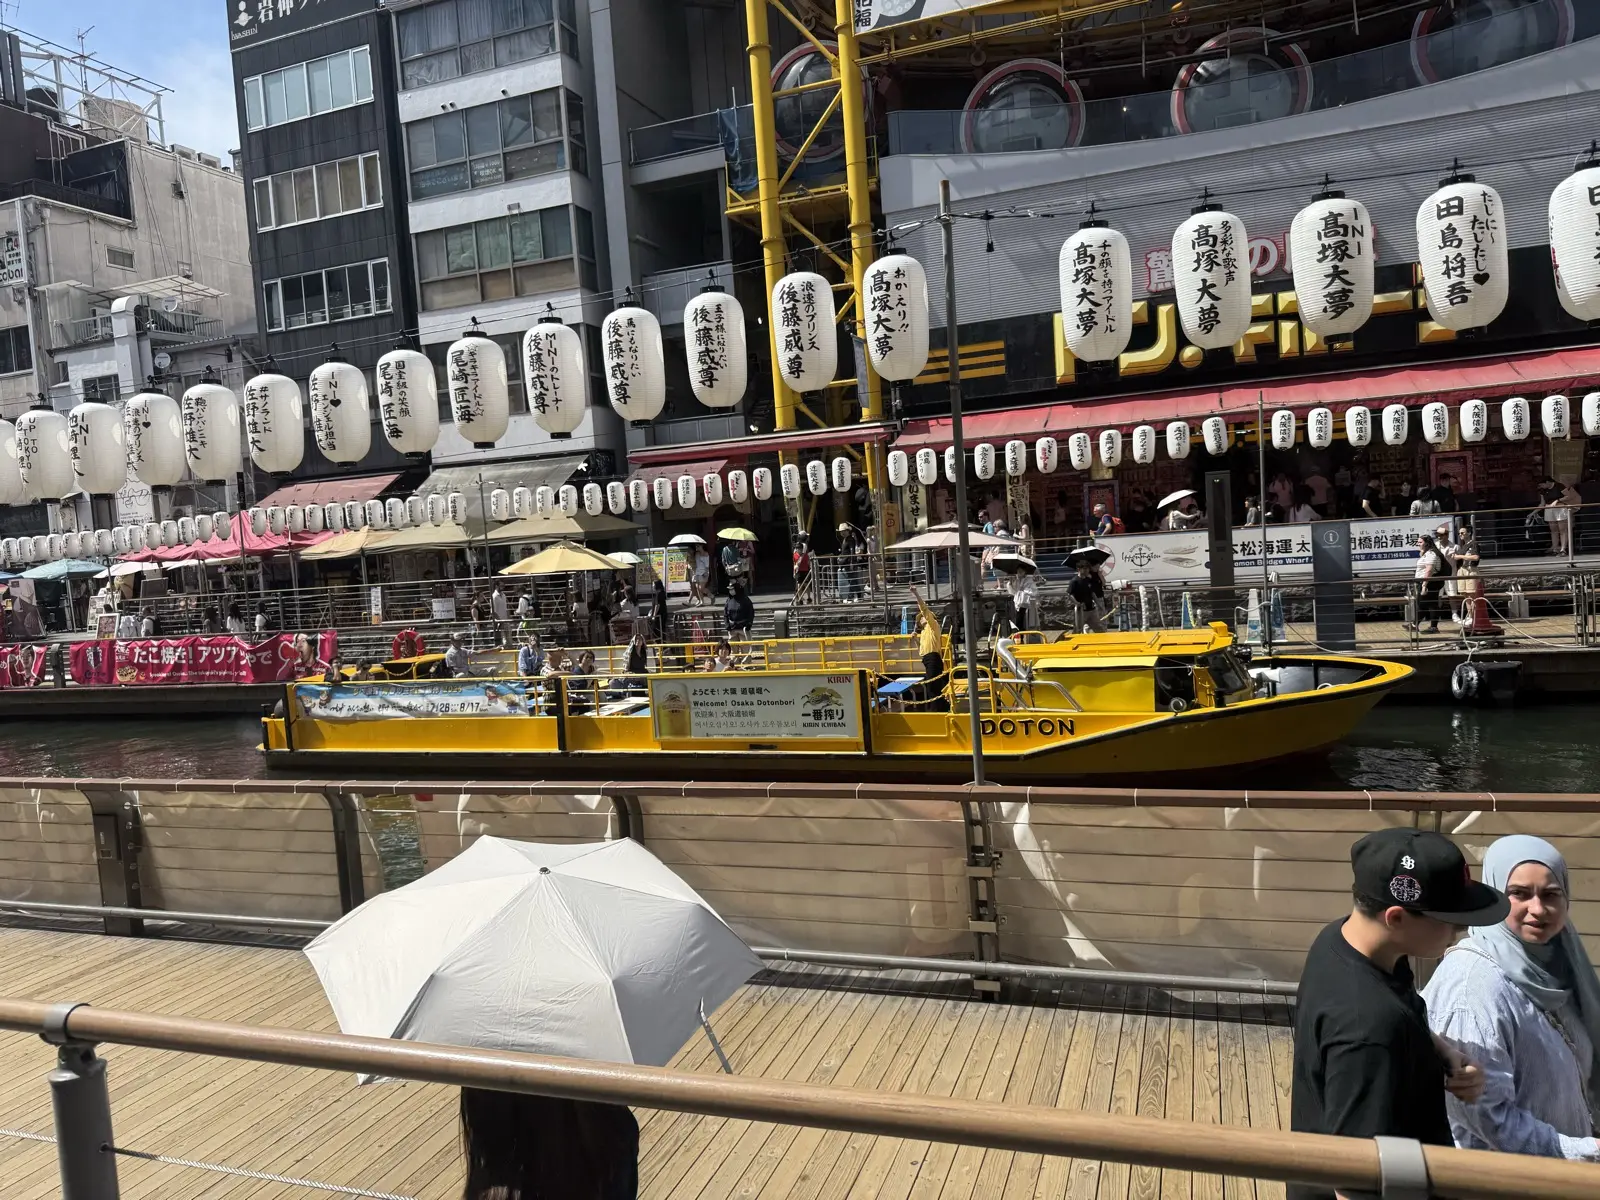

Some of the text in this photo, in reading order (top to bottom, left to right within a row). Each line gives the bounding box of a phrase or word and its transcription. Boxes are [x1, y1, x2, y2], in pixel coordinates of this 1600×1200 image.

[1219, 220, 1239, 287] 多彩な歌声
[1350, 207, 1364, 256] INI
[1436, 195, 1471, 307] 田島将吾
[800, 281, 820, 351] 浪速のプリンス
[1097, 239, 1117, 334] 千の顔を持つアイドル
[606, 318, 631, 405] 後藤威尊
[692, 305, 719, 389] 後藤威尊
[714, 303, 727, 369] 王子様になりたい
[779, 283, 805, 379] 後藤威尊
[329, 371, 338, 400] INI
[379, 361, 403, 440] 尾崎匠海
[395, 360, 411, 418] 国宝級の笑顔
[450, 349, 475, 423] 尾崎匠海
[527, 332, 550, 414] 後藤威尊
[79, 413, 89, 446] INI
[245, 385, 266, 452] 佐野雄大
[321, 394, 337, 451] エンジェル担当
[460, 702, 480, 712] 8/17
[692, 688, 720, 696] ようこそ!
[723, 687, 737, 695] 大阪
[827, 676, 851, 684] KIRIN
[801, 709, 844, 720] 一番搾り
[981, 718, 1075, 736] DOTON
